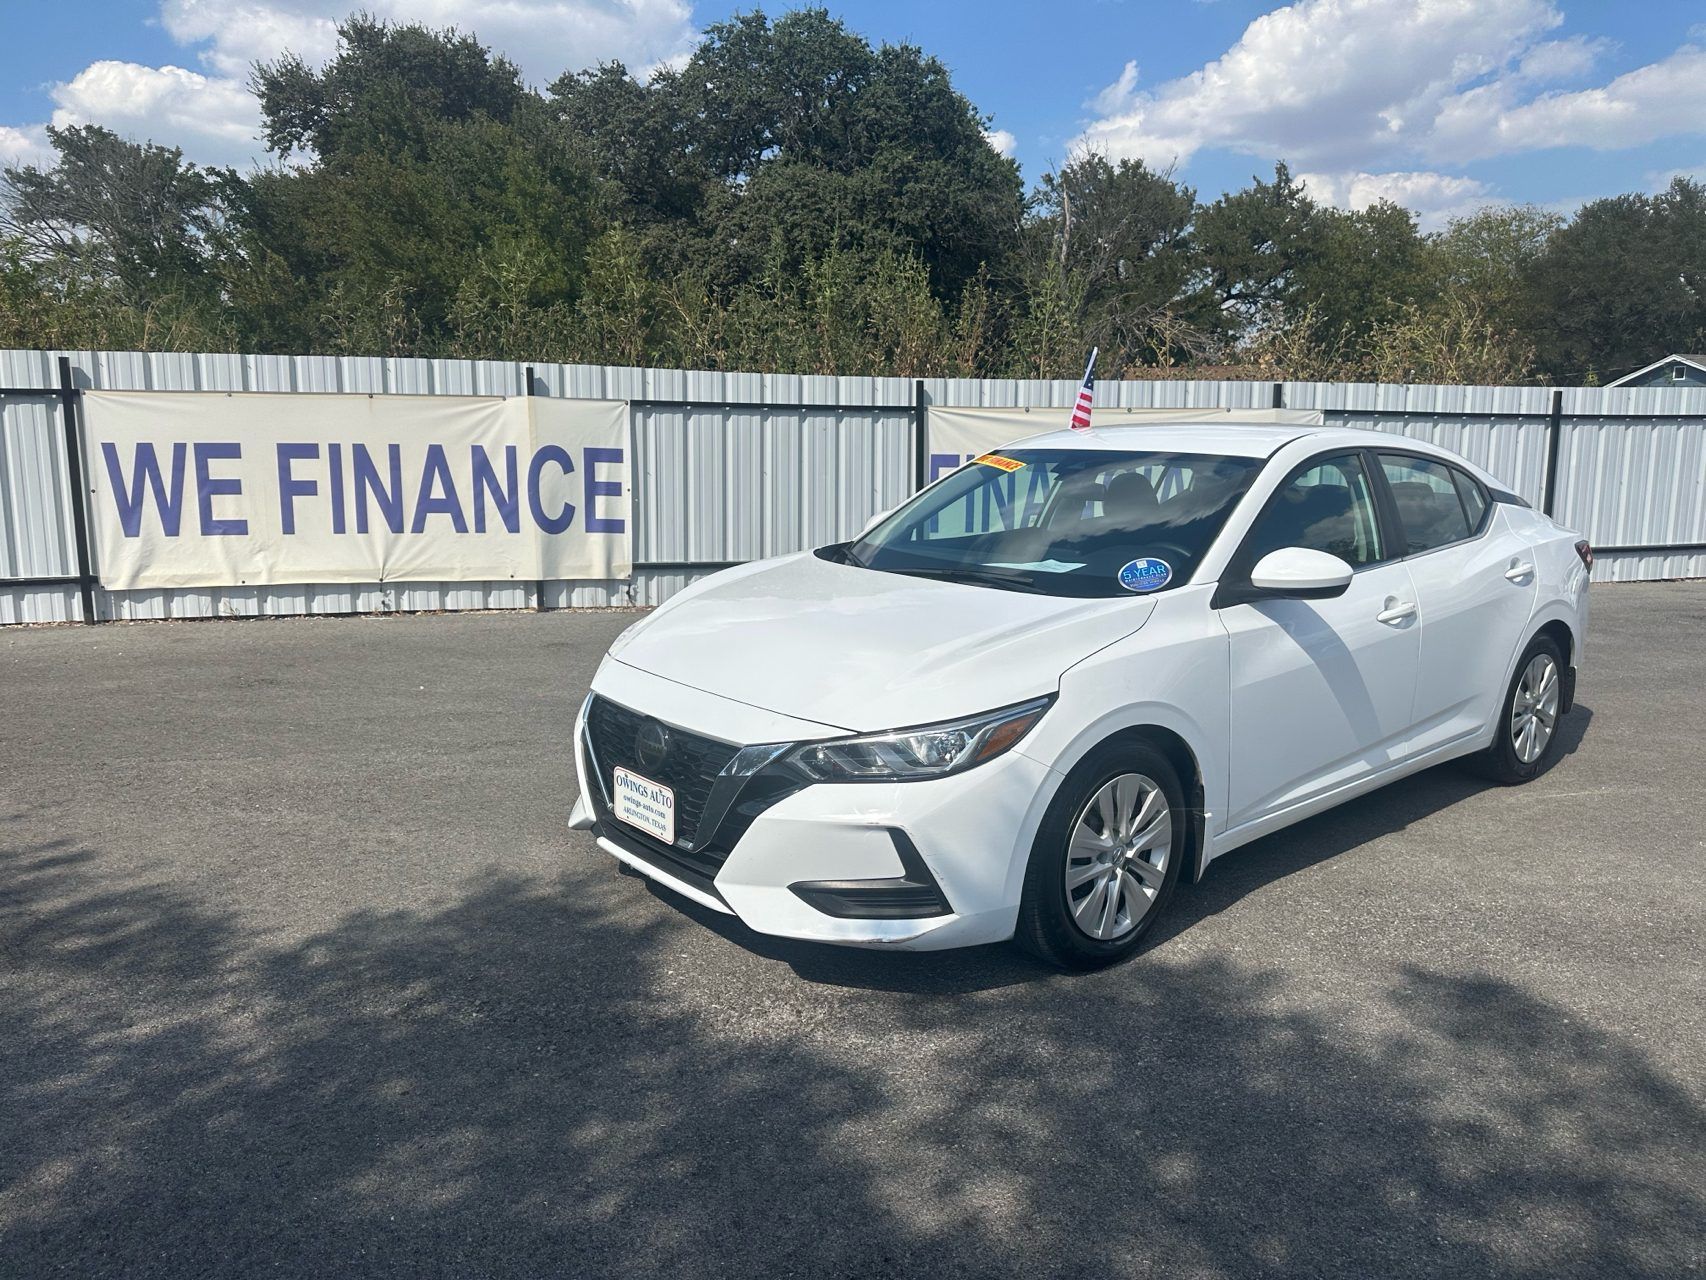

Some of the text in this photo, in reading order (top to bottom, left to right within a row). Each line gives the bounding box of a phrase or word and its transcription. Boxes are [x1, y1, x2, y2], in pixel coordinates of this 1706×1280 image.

[100, 442, 626, 538] WE FINANCE
[1123, 564, 1166, 580] 5 YEAR
[616, 774, 672, 809] OWINGS AUTO
[623, 795, 667, 820] owings-auto.com
[651, 817, 668, 833] TEXAS
